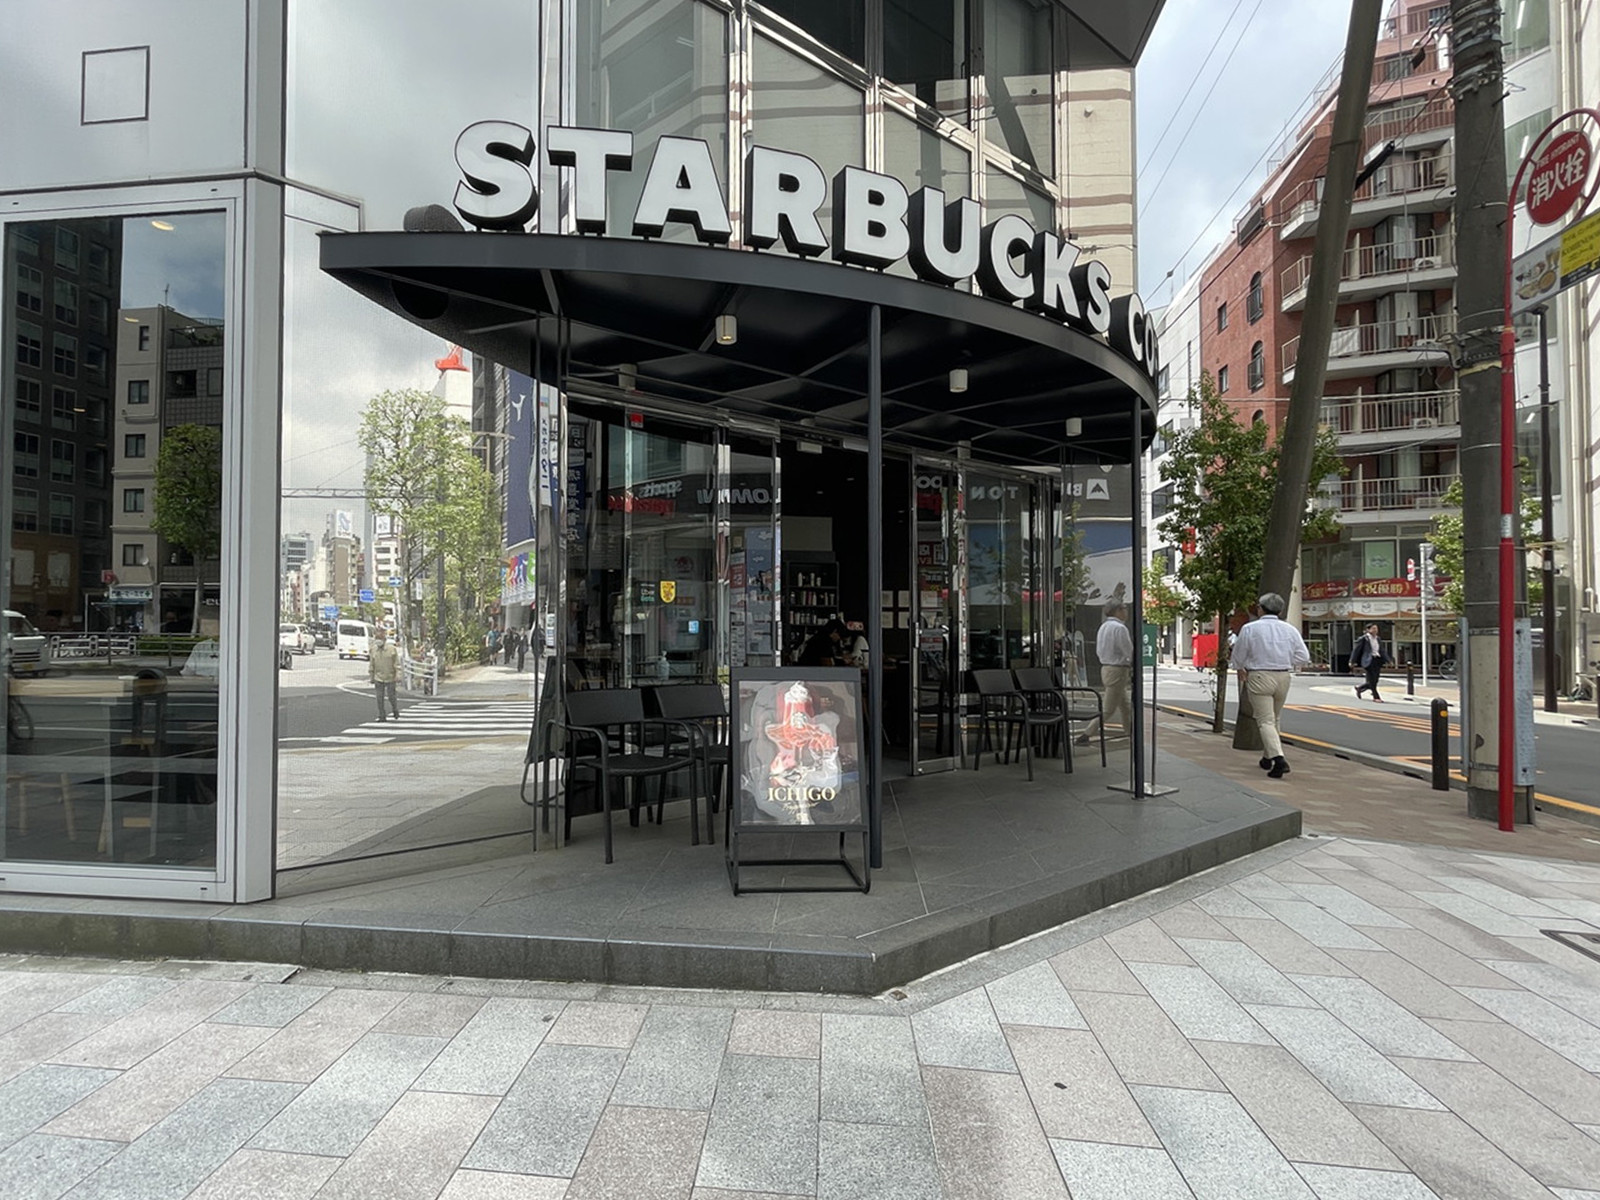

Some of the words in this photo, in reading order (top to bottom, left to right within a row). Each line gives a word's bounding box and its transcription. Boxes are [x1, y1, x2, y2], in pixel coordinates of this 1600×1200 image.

[1531, 147, 1586, 210] 消火栓
[453, 120, 1112, 335] STARBUCKS
[768, 787, 836, 801] ICHIGO
